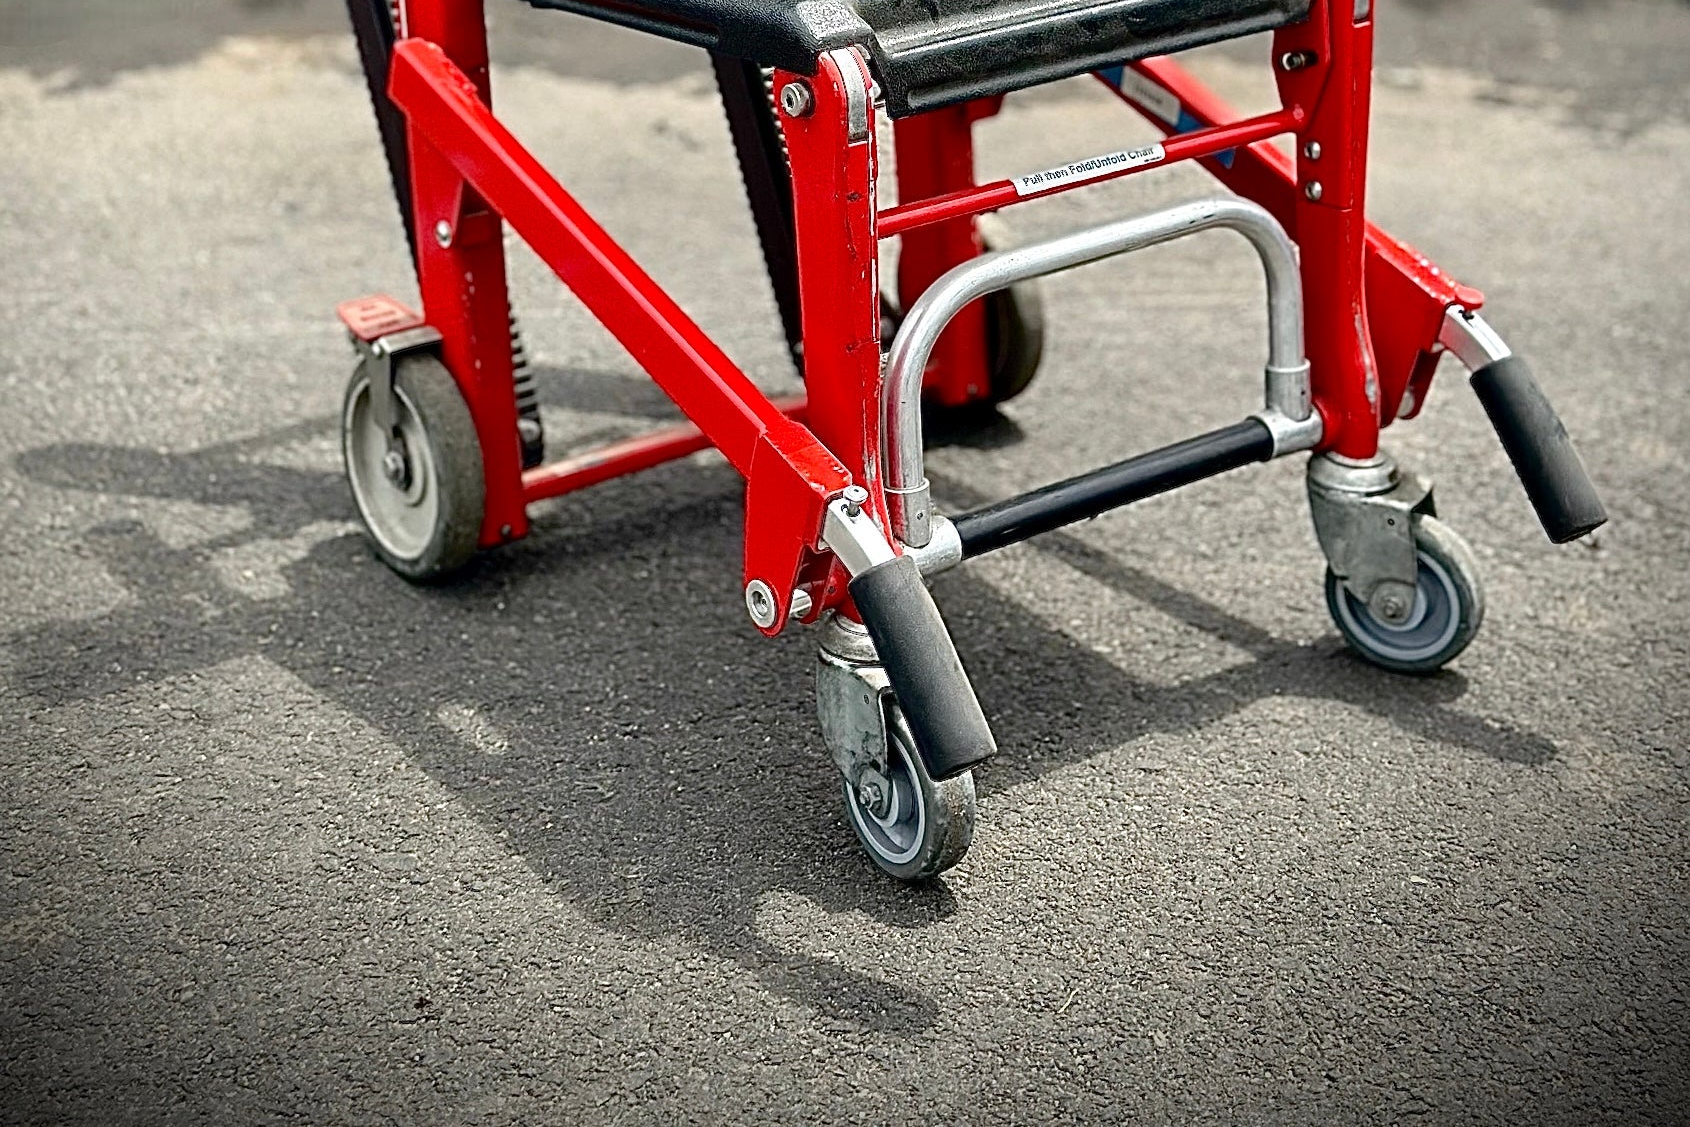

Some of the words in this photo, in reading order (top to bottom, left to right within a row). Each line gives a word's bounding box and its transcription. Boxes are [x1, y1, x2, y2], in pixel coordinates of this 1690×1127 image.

[1022, 174, 1044, 187] Pull
[1045, 169, 1069, 182] then
[1068, 153, 1127, 175] Fold/Unfold
[1127, 147, 1155, 160] Chair
